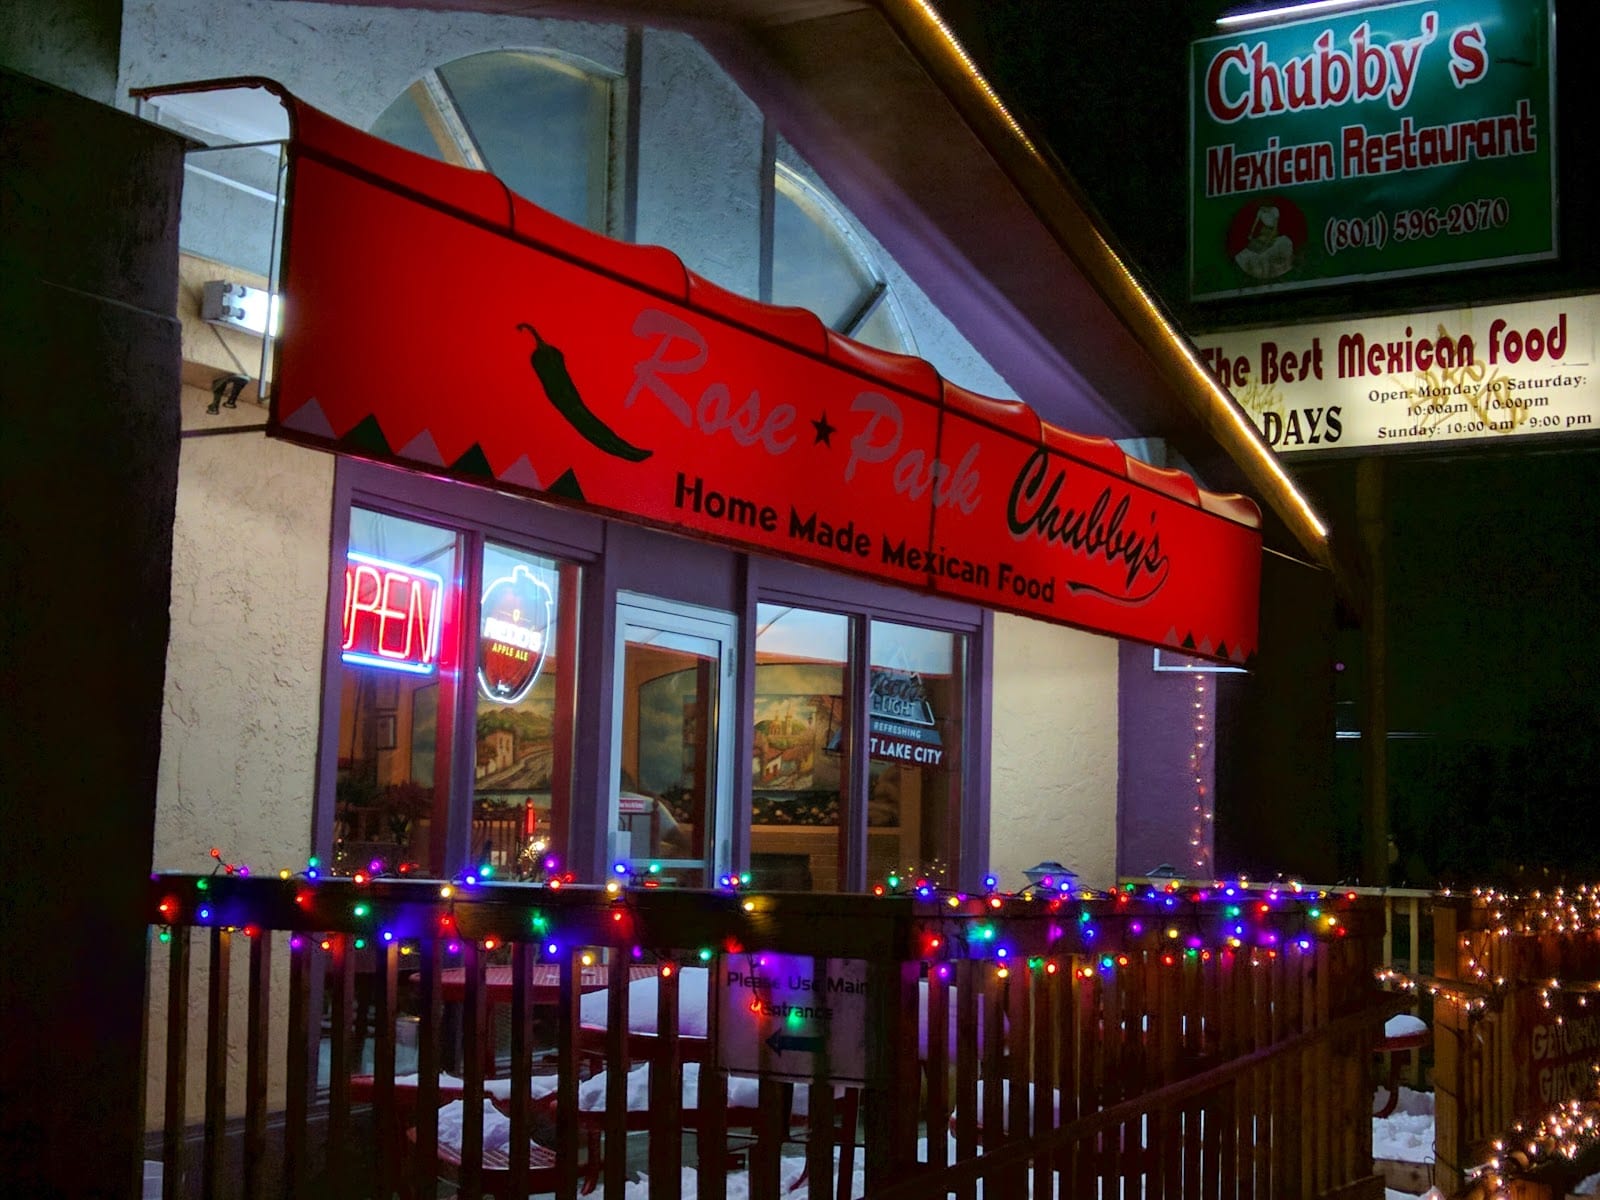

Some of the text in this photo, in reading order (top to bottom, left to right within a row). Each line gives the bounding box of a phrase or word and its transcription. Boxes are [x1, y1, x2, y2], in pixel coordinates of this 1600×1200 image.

[1207, 100, 1536, 197] Mexican Restaurant
[1325, 198, 1509, 255] (801) 596-2070
[1261, 338, 1323, 385] Best
[1338, 326, 1474, 378] Mexican
[1418, 382, 1481, 398] Monday
[1486, 380, 1502, 392] to
[1507, 374, 1587, 391] Saturday:
[625, 308, 983, 515] Rose Park
[1407, 401, 1469, 417] 10:00am
[1484, 396, 1549, 412] 10:00pm
[1262, 406, 1342, 447] DAYS
[1378, 424, 1441, 441] Sunday:
[1446, 420, 1484, 435] 10:00
[1489, 419, 1514, 431] am
[1529, 414, 1561, 429] 9:00
[1566, 412, 1592, 428] pm
[675, 472, 1055, 603] Home Made Mexican Food
[1006, 446, 1171, 607] Chubby's
[491, 642, 529, 662] APPLE ALE
[882, 695, 917, 717] LIGHT
[874, 721, 921, 739] REFRESHING
[880, 740, 911, 760] LAKE
[914, 747, 942, 765] CITY
[727, 972, 781, 989] Please
[788, 975, 818, 992] Use
